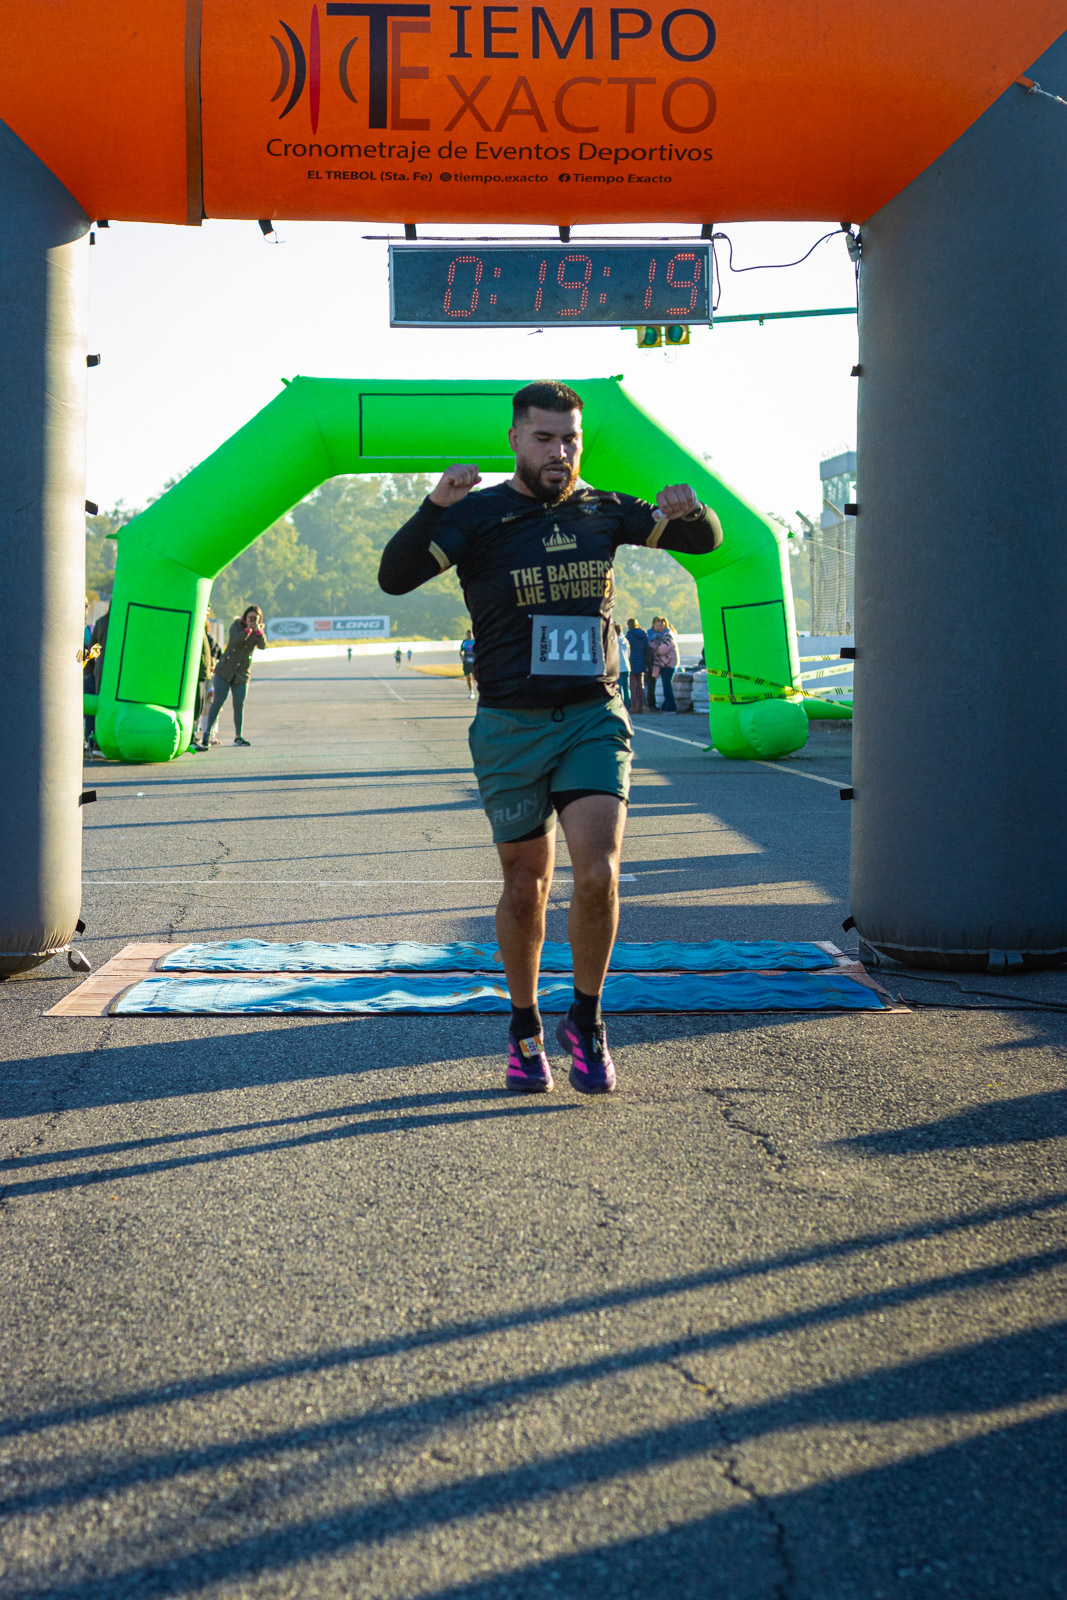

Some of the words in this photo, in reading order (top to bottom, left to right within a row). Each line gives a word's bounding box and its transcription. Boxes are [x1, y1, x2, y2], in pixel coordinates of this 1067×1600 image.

[266, 138, 431, 163] Cronometraje
[437, 140, 468, 159] de
[475, 141, 571, 160] Eventos
[578, 142, 713, 165] Deportivos
[307, 170, 323, 180] EL
[325, 170, 377, 181] TREBOL
[380, 171, 410, 182] (Sta.
[412, 171, 433, 182] Fe)
[454, 172, 548, 184] tiempo.exacto
[572, 173, 625, 185] Tiempo
[627, 173, 672, 184] Exacto
[510, 566, 544, 588] THE
[546, 560, 611, 583] BARBERS
[335, 620, 381, 629] LONG
[548, 628, 591, 661] 121
